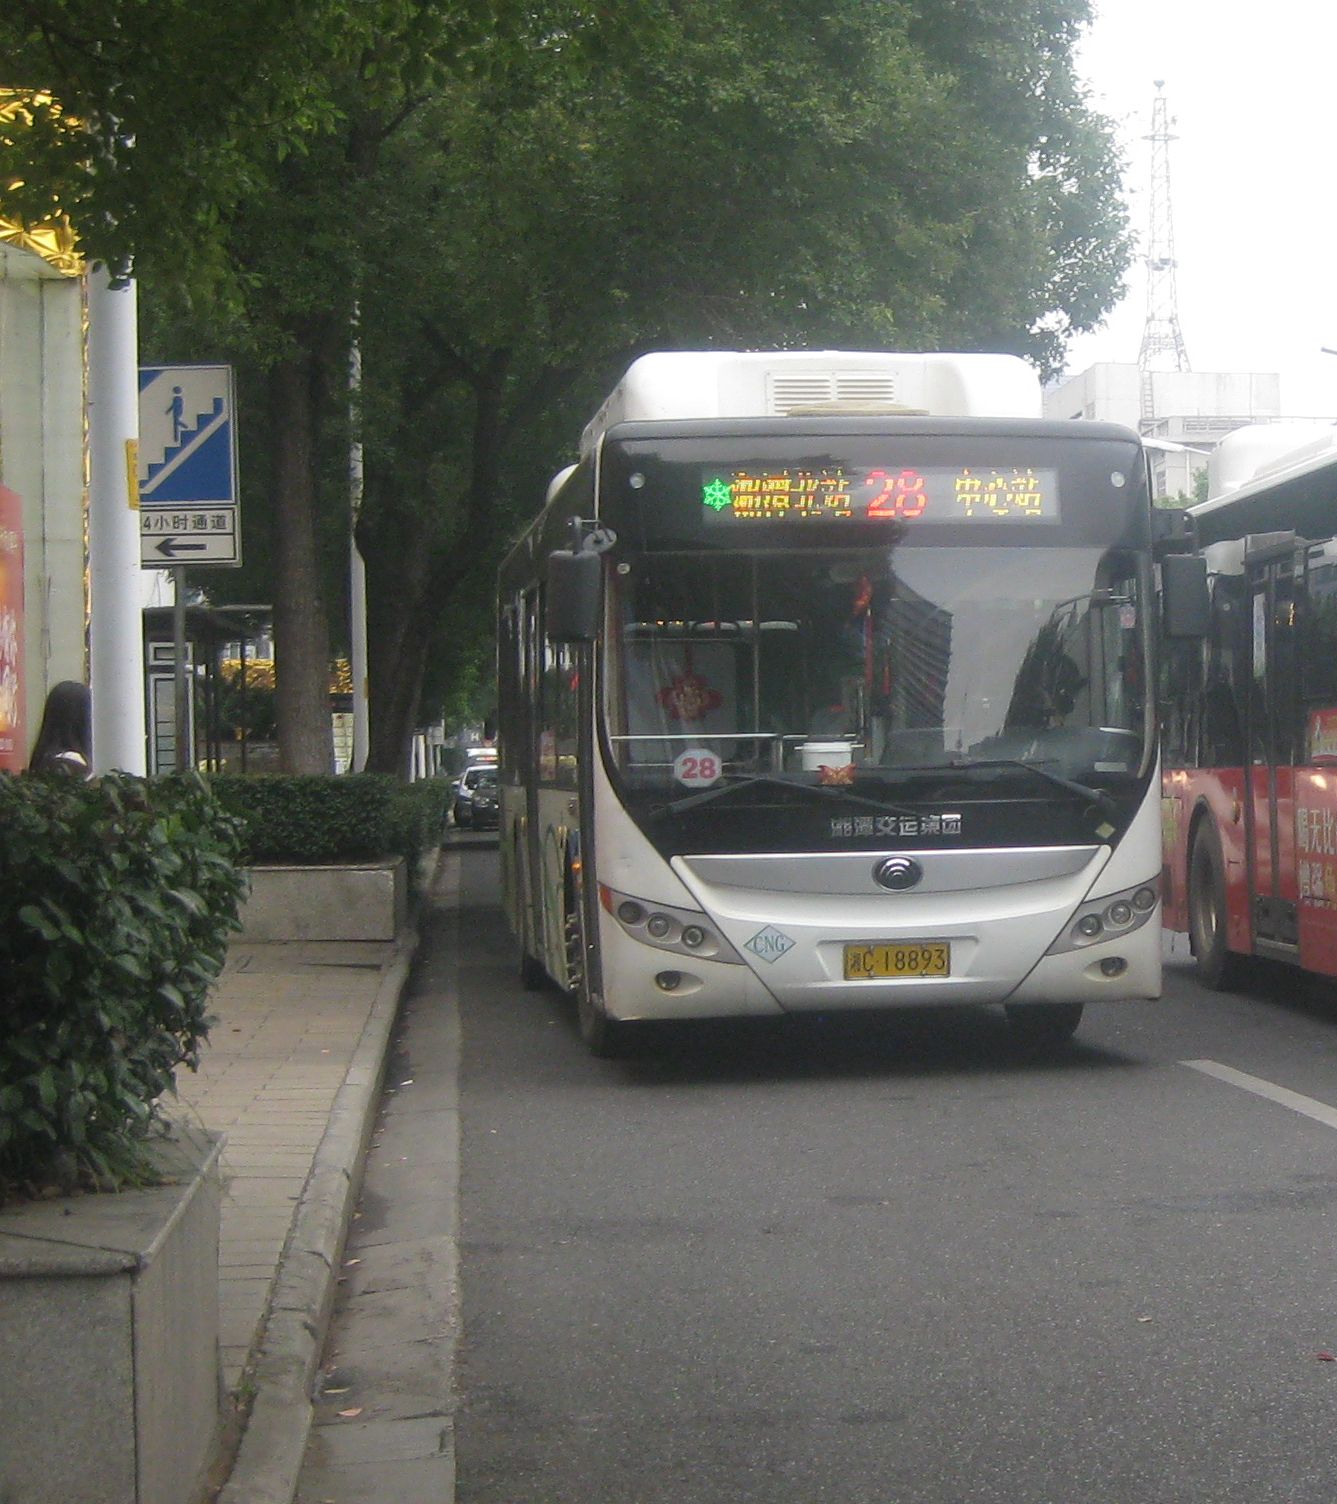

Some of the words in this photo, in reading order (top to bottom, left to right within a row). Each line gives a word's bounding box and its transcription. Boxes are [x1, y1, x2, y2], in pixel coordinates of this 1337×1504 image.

[866, 470, 927, 518] 28
[955, 469, 1041, 517] 中心站
[143, 514, 227, 530] 4小时通道
[681, 757, 717, 779] 28
[831, 814, 961, 837] 湘潭交运集团
[752, 934, 786, 954] CNG
